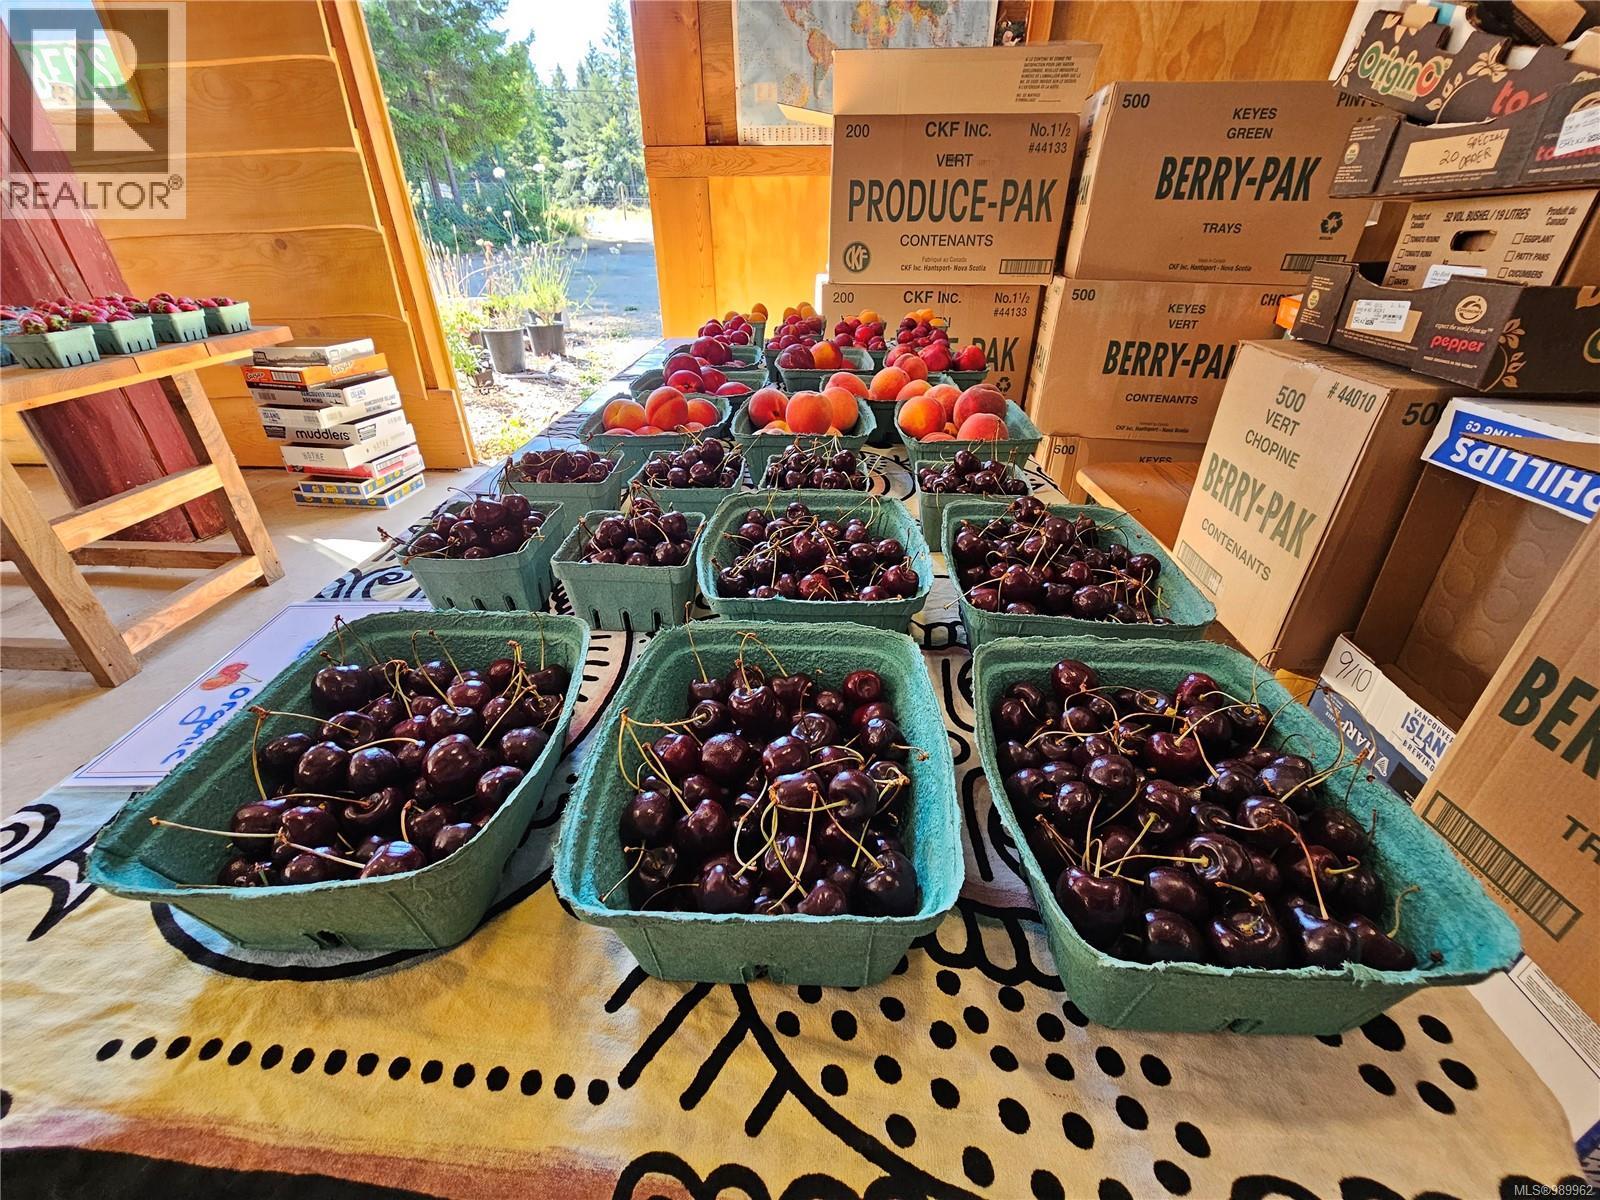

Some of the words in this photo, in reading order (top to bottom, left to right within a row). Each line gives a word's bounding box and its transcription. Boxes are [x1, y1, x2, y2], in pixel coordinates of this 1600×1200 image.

[1121, 94, 1150, 109] 500
[1232, 107, 1278, 120] KEYES
[845, 124, 870, 138] 200
[925, 121, 960, 137] CKF
[1226, 127, 1273, 139] GREEN
[1028, 142, 1068, 154] #44133
[936, 154, 973, 167] VERT
[1439, 149, 1459, 165] 20
[1155, 156, 1323, 201] BERRY-PAK
[848, 178, 1058, 223] PRODUCE-PAK
[1466, 210, 1490, 222] BUSHEL
[1504, 208, 1532, 220] LITRES
[1202, 223, 1242, 234] TRAYS
[900, 234, 994, 247] CONTENANTS
[1522, 234, 1556, 243] EGGPLANT
[1508, 270, 1543, 278] CUCUMBERS
[833, 292, 854, 304] 200
[903, 290, 933, 304] CKF
[1071, 288, 1096, 301] 500
[993, 307, 1027, 317] #44133
[1168, 303, 1206, 315] KEYES
[1168, 319, 1199, 330] VERT
[1430, 335, 1486, 352] pepper
[1125, 393, 1199, 404] CONTENANTS
[1276, 385, 1306, 413] 500
[1402, 402, 1440, 426] 50
[1265, 409, 1300, 437] VERT
[295, 428, 350, 440] muddlers
[1054, 444, 1075, 454] 500
[1245, 429, 1300, 469] CHOPINE
[1201, 452, 1318, 560] BERRY-PAK
[1201, 518, 1271, 581] CONTENANTS
[1335, 651, 1372, 692] 9/10
[1402, 741, 1436, 772] BREWING
